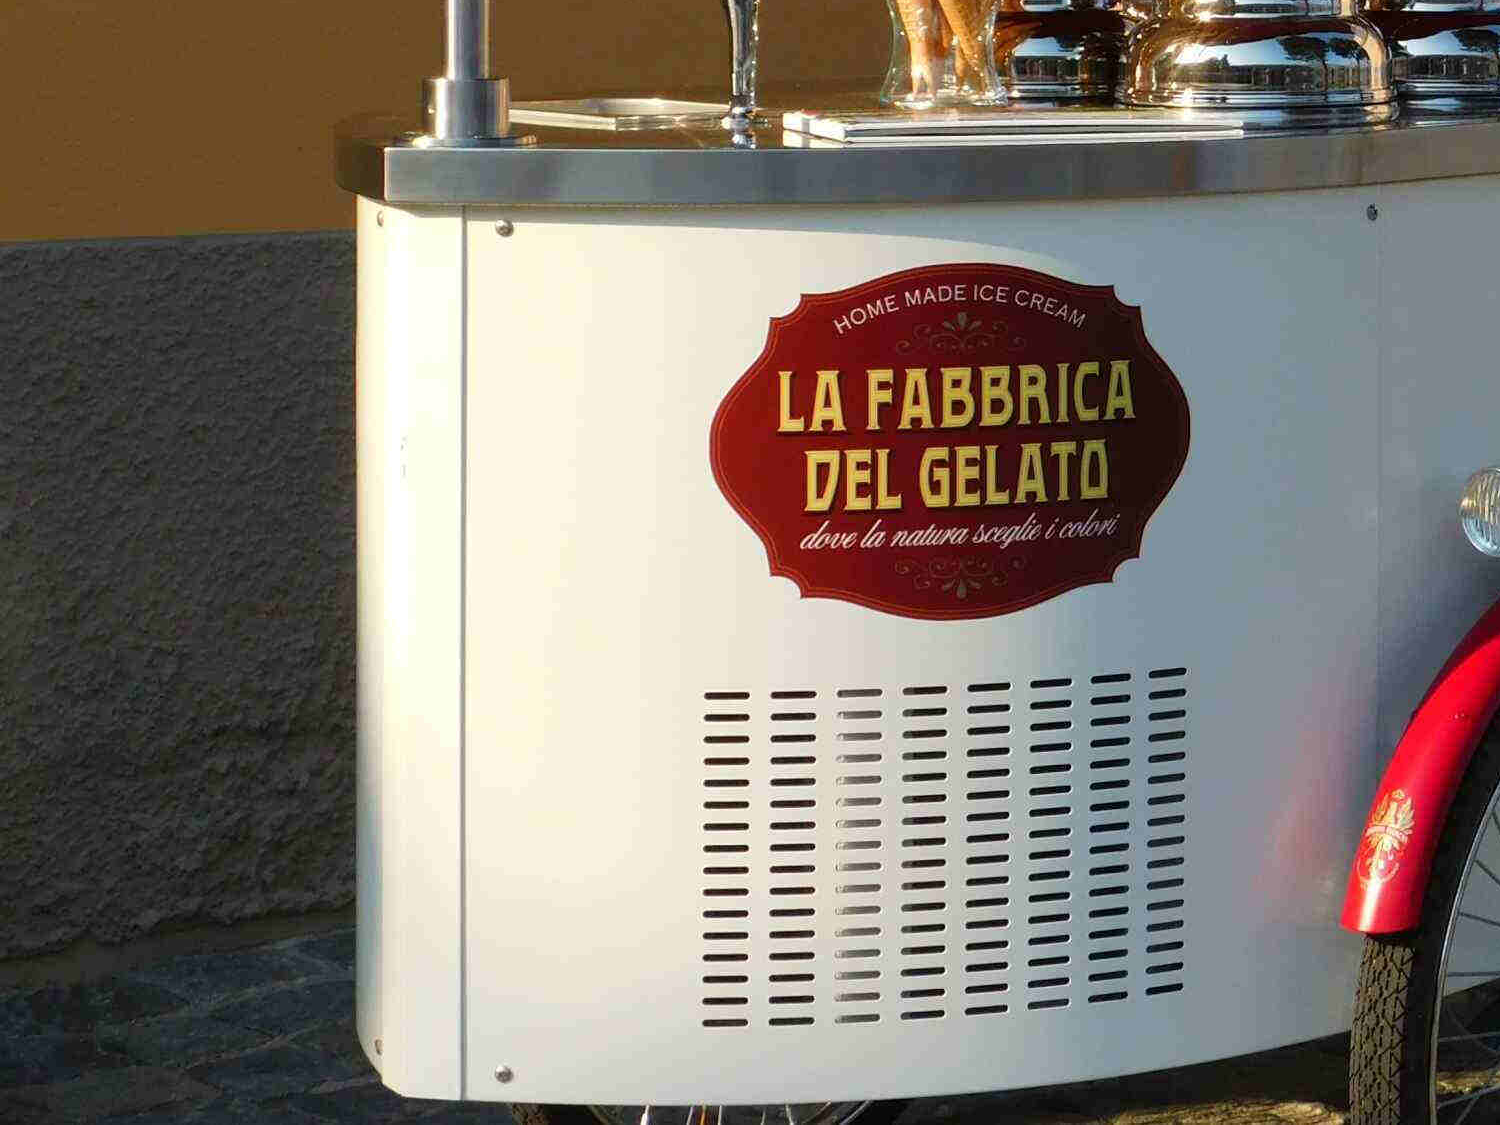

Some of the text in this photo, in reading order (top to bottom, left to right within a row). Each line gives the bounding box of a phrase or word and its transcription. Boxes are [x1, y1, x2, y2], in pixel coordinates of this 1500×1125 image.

[833, 284, 1087, 335] HOME MADE ICE CREAM
[777, 359, 1137, 433] LA FABBRICA
[804, 438, 1109, 513] DEL GELATO
[800, 507, 1121, 550] dove la natura sceglie i colori
